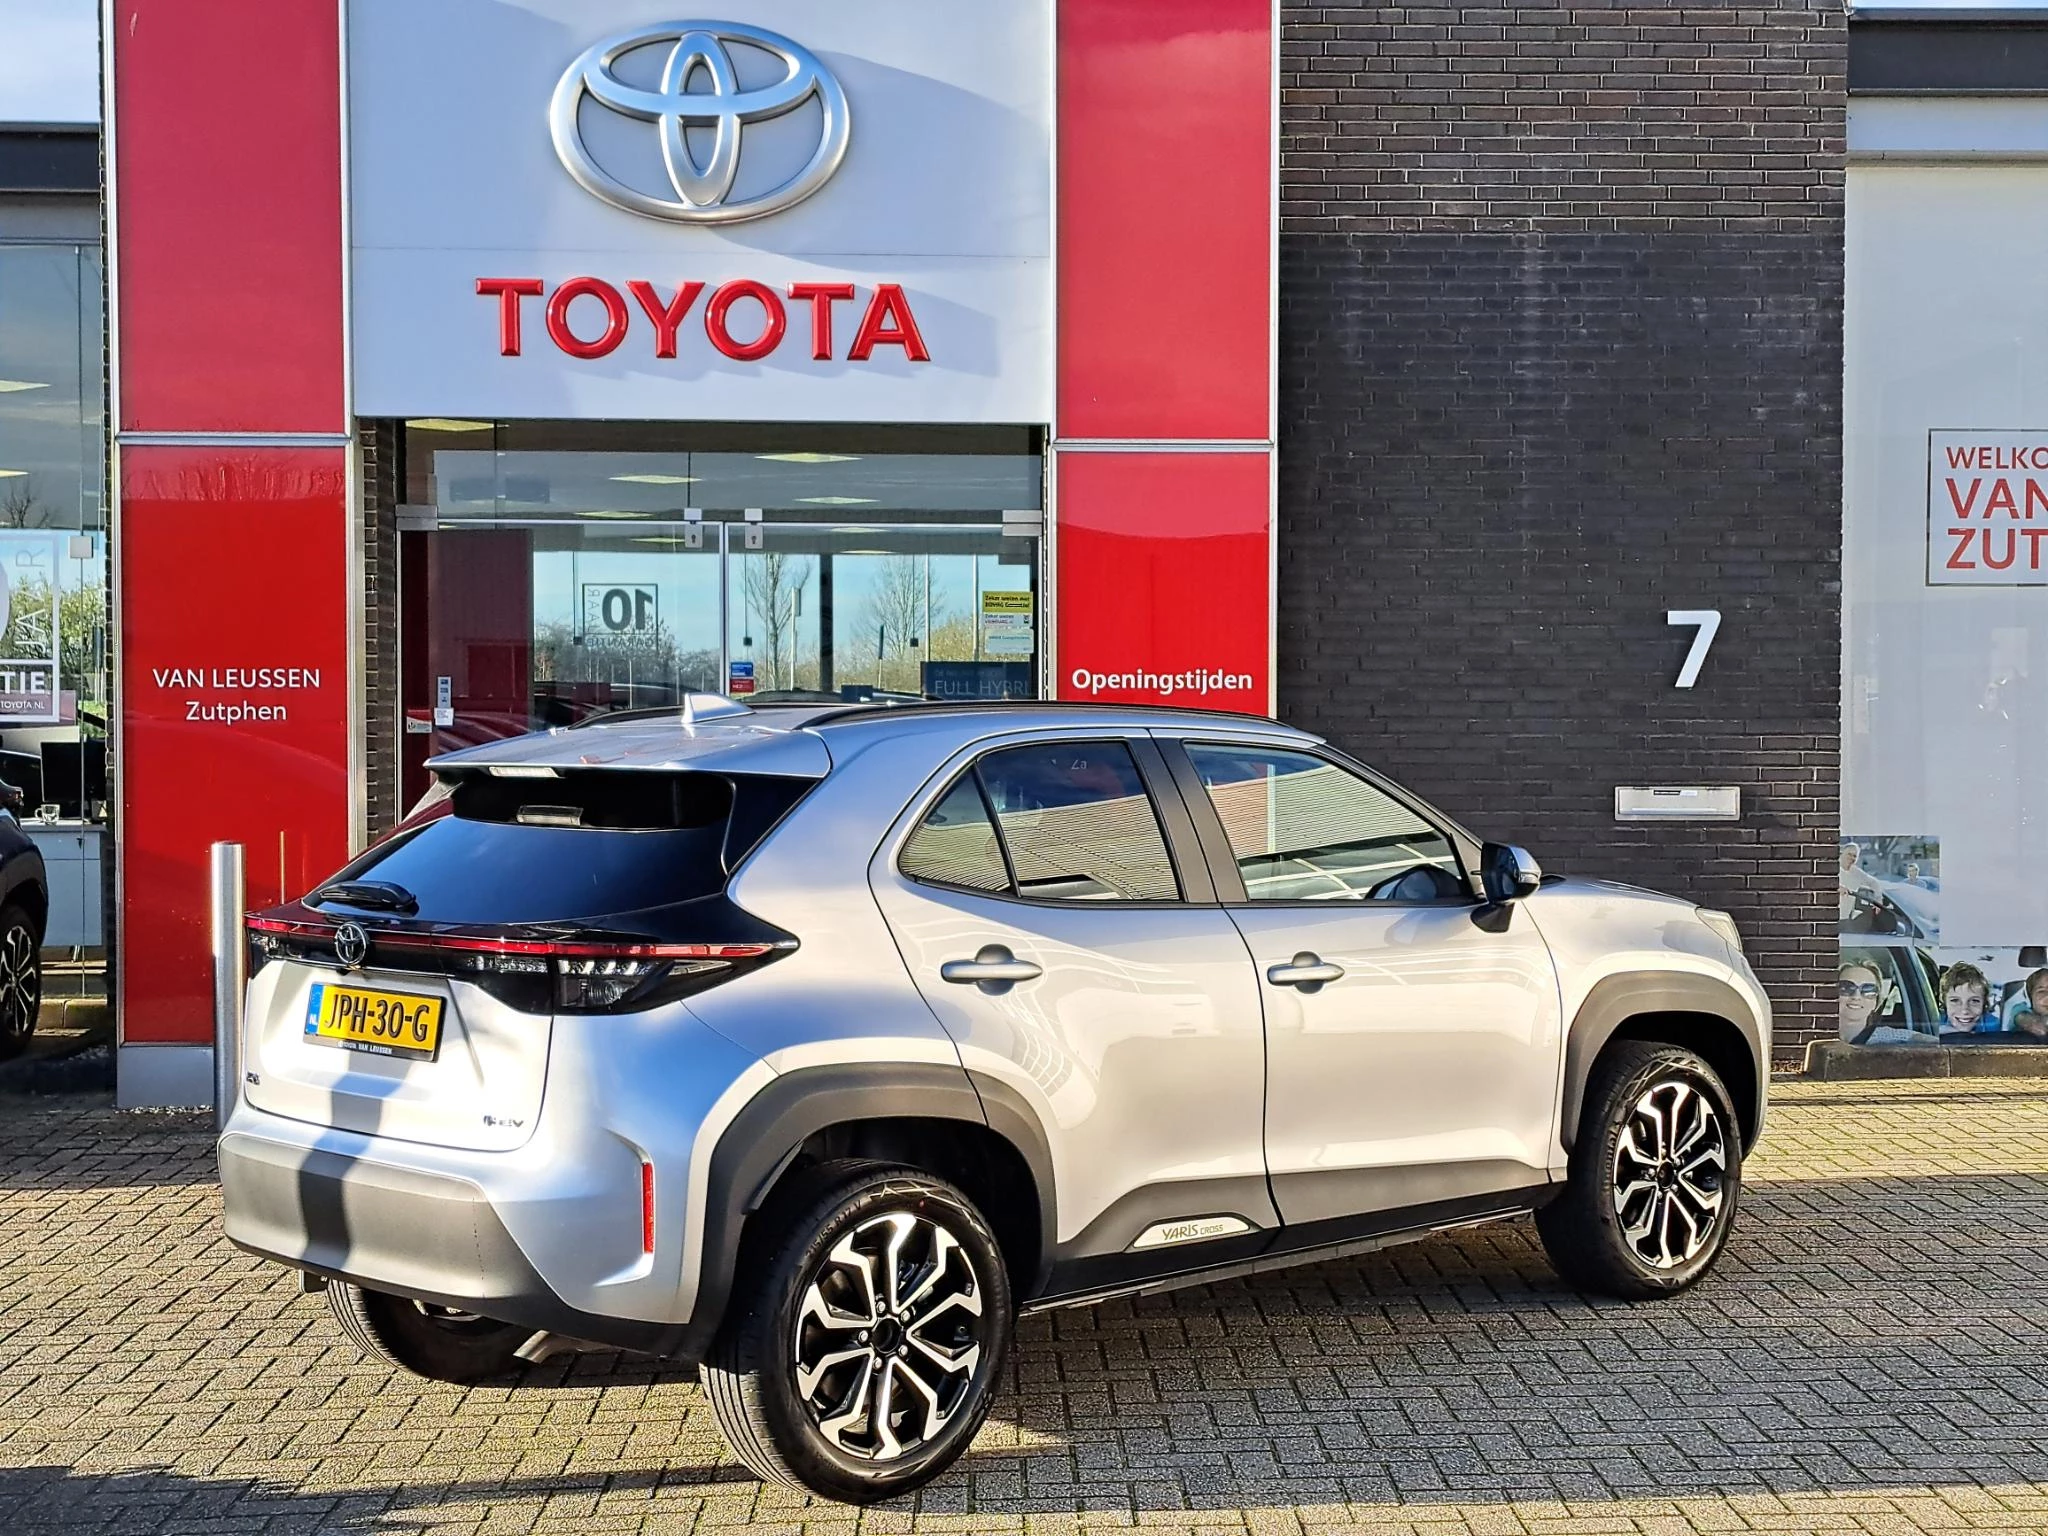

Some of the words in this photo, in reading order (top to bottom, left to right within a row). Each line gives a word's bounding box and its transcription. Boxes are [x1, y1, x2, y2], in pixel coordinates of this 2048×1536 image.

[475, 277, 931, 361] TOYOTA
[1945, 446, 2048, 470] WELKO
[1945, 477, 2048, 520] VAN
[1946, 527, 2048, 570] ZUT
[1667, 610, 1722, 688] 7
[152, 668, 204, 688] VAN
[212, 668, 320, 688] LEUSSEN
[935, 680, 975, 696] FULL
[1071, 668, 1253, 695] Openingstijden
[186, 700, 287, 726] Zutphen
[325, 994, 431, 1042] JPH-30-G
[1162, 1223, 1199, 1241] YARIS
[1200, 1224, 1224, 1236] CROSS
